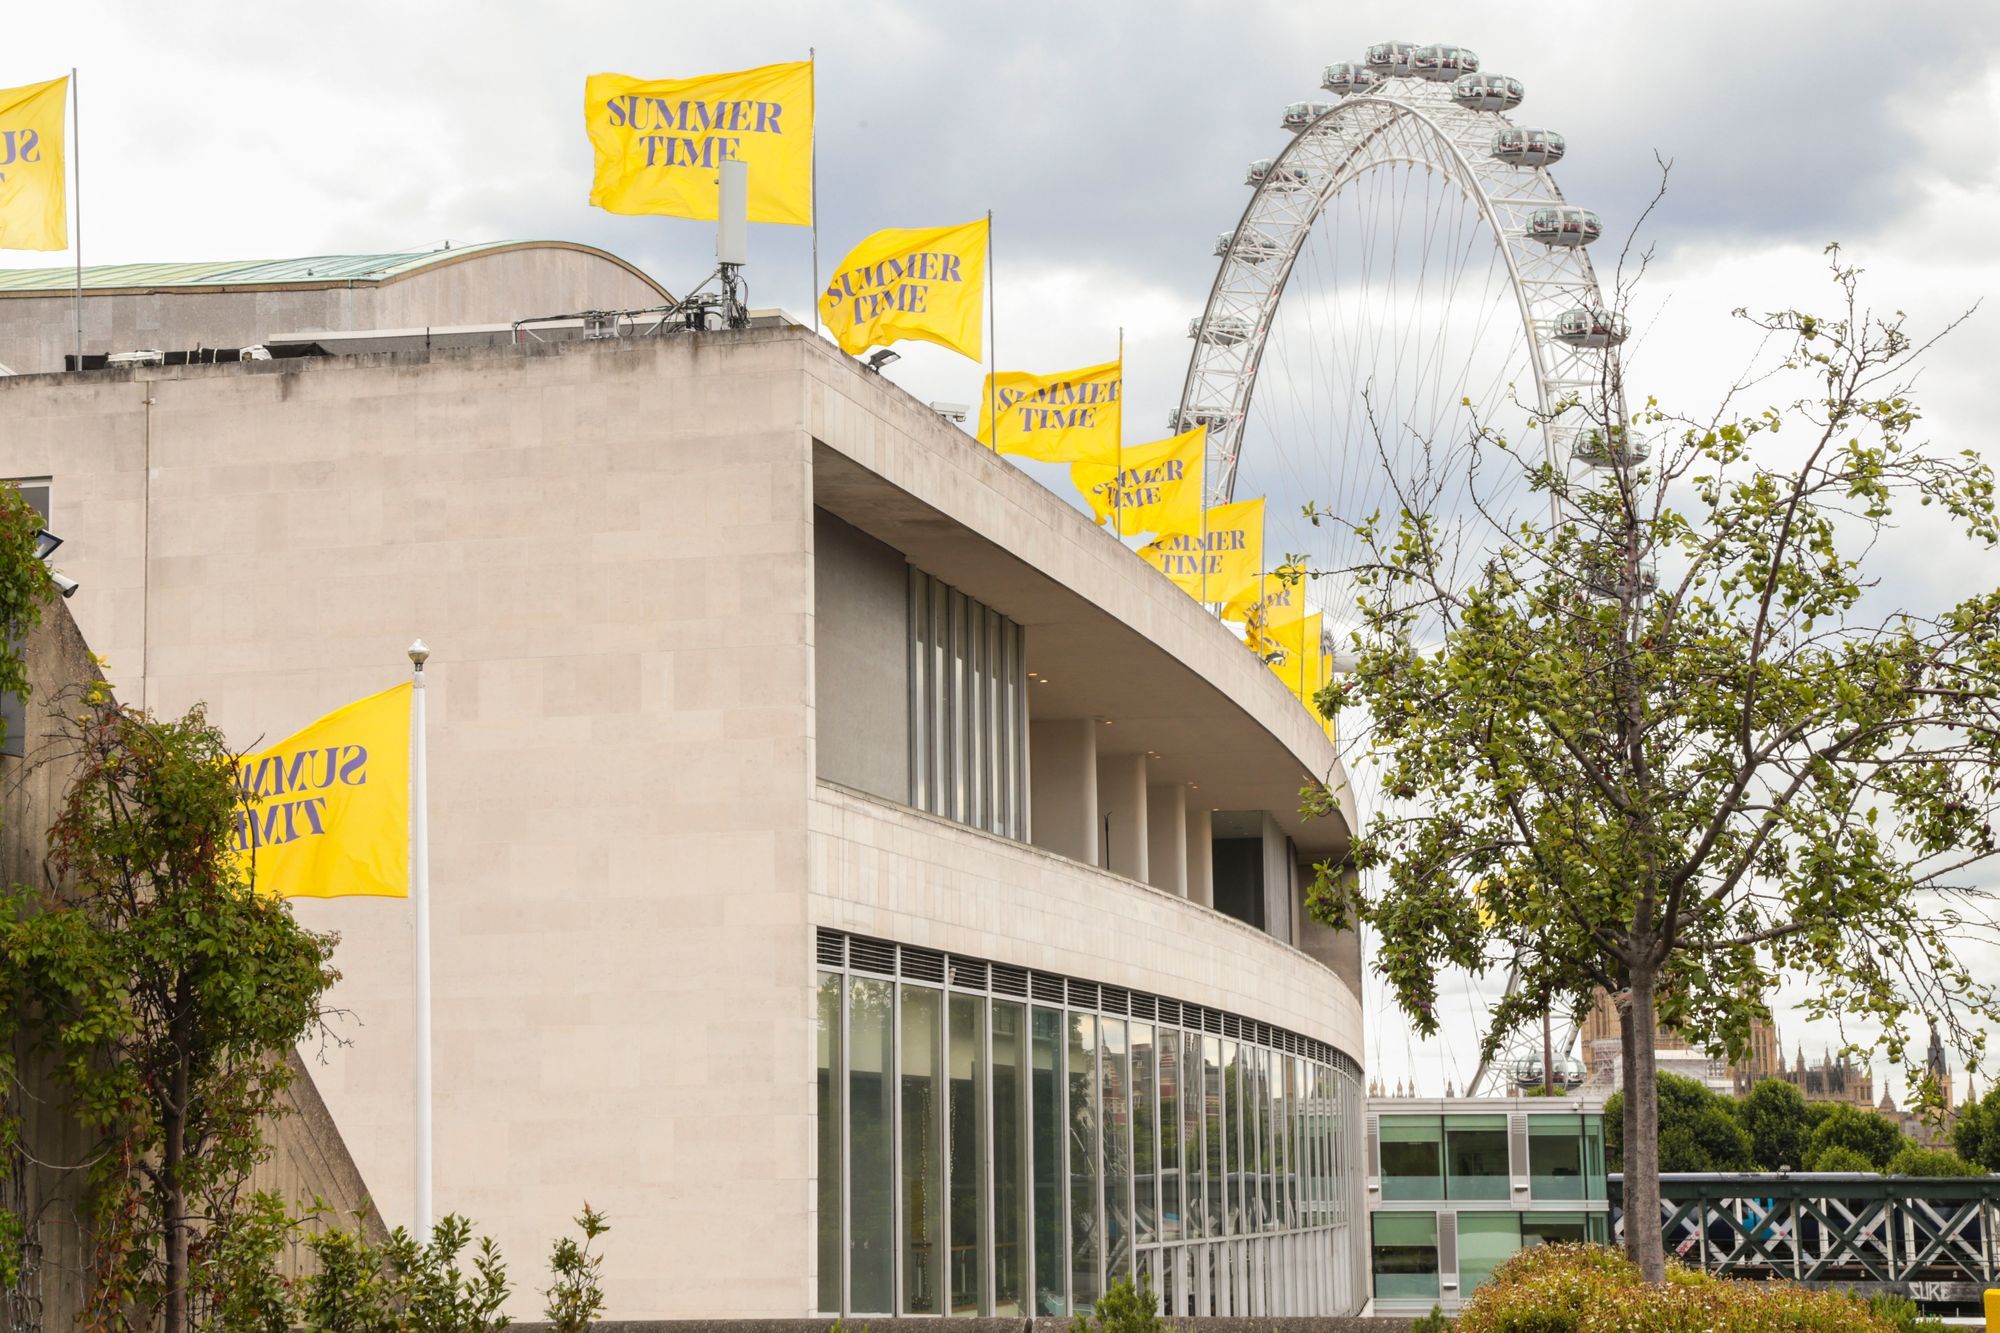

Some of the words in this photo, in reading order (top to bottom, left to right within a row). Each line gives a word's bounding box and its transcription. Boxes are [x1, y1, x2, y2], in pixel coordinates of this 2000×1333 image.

[606, 95, 783, 134] SUMMER
[638, 135, 741, 169] TIME
[826, 252, 963, 309] SUMMER
[853, 283, 929, 326] TIME
[1018, 407, 1097, 432] TIME
[1149, 529, 1246, 552] MMER
[1159, 554, 1224, 575] TIME
